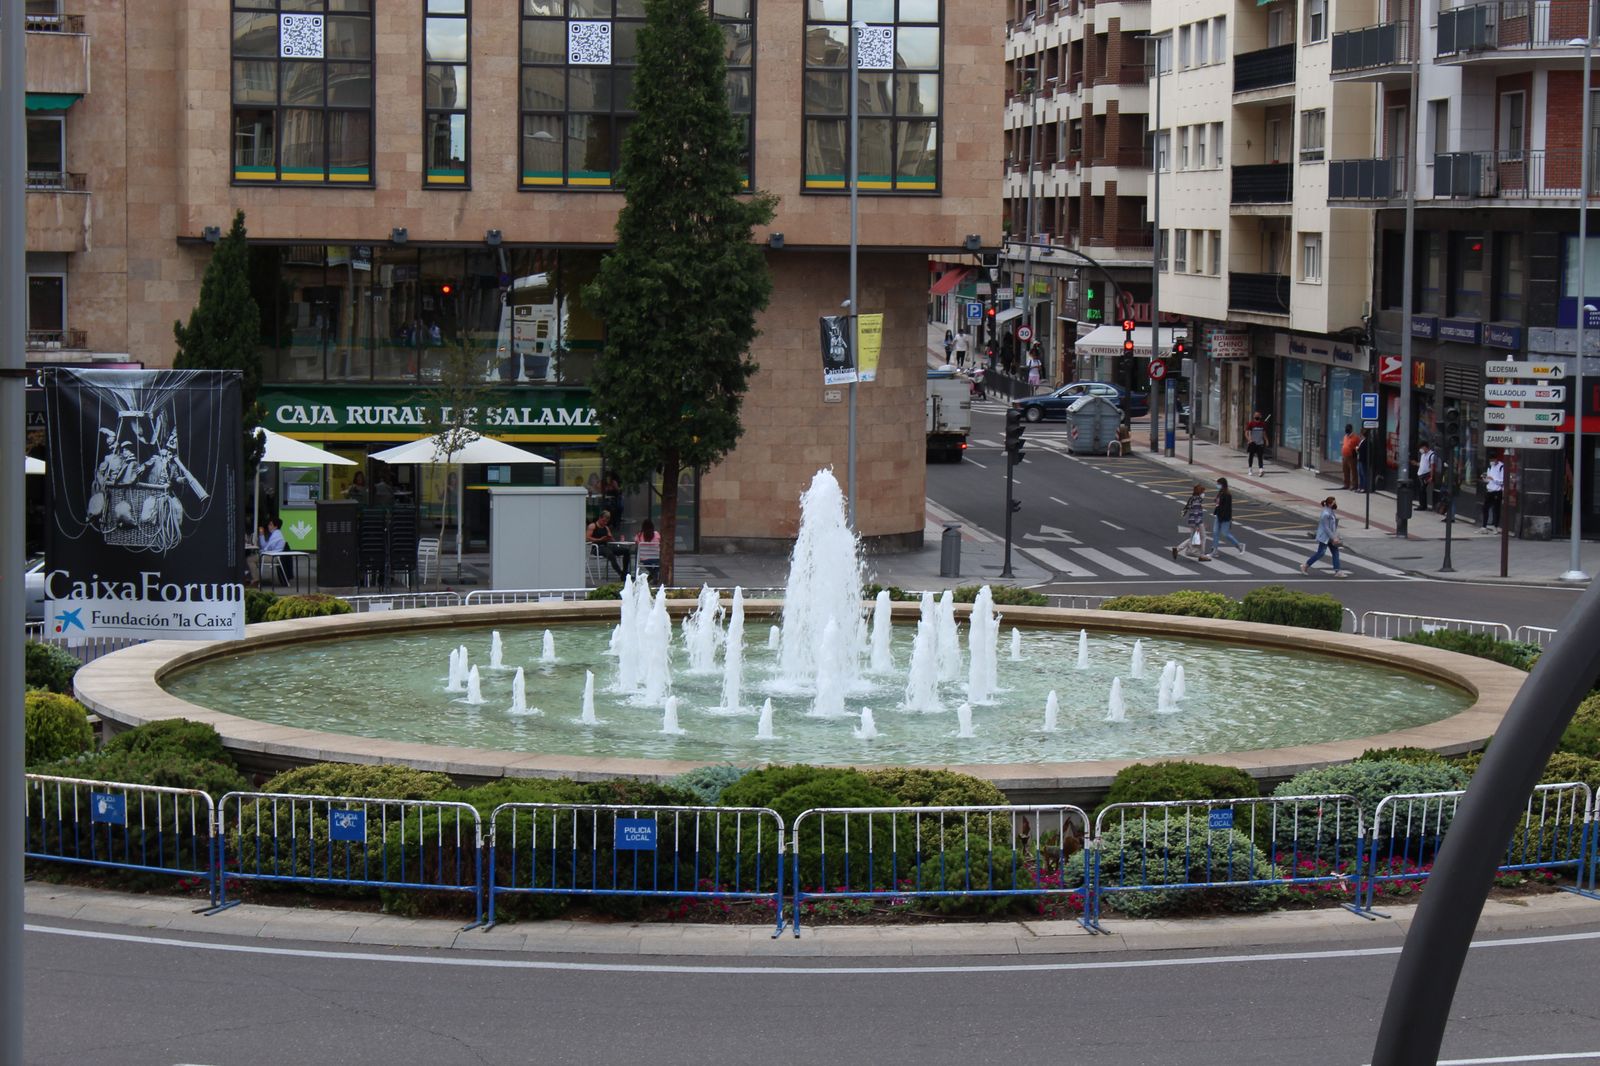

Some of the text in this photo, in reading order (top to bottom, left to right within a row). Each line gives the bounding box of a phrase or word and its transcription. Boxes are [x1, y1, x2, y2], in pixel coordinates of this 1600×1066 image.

[970, 304, 979, 317] P
[1020, 329, 1029, 337] 30
[1488, 389, 1527, 397] VALLADOLID
[276, 405, 338, 426] CAJA
[346, 406, 432, 425] RURAL
[1486, 435, 1513, 443] ZAMORA
[45, 569, 245, 602] CaixaForum
[91, 610, 169, 627] Fundación
[624, 826, 651, 834] POLICIA
